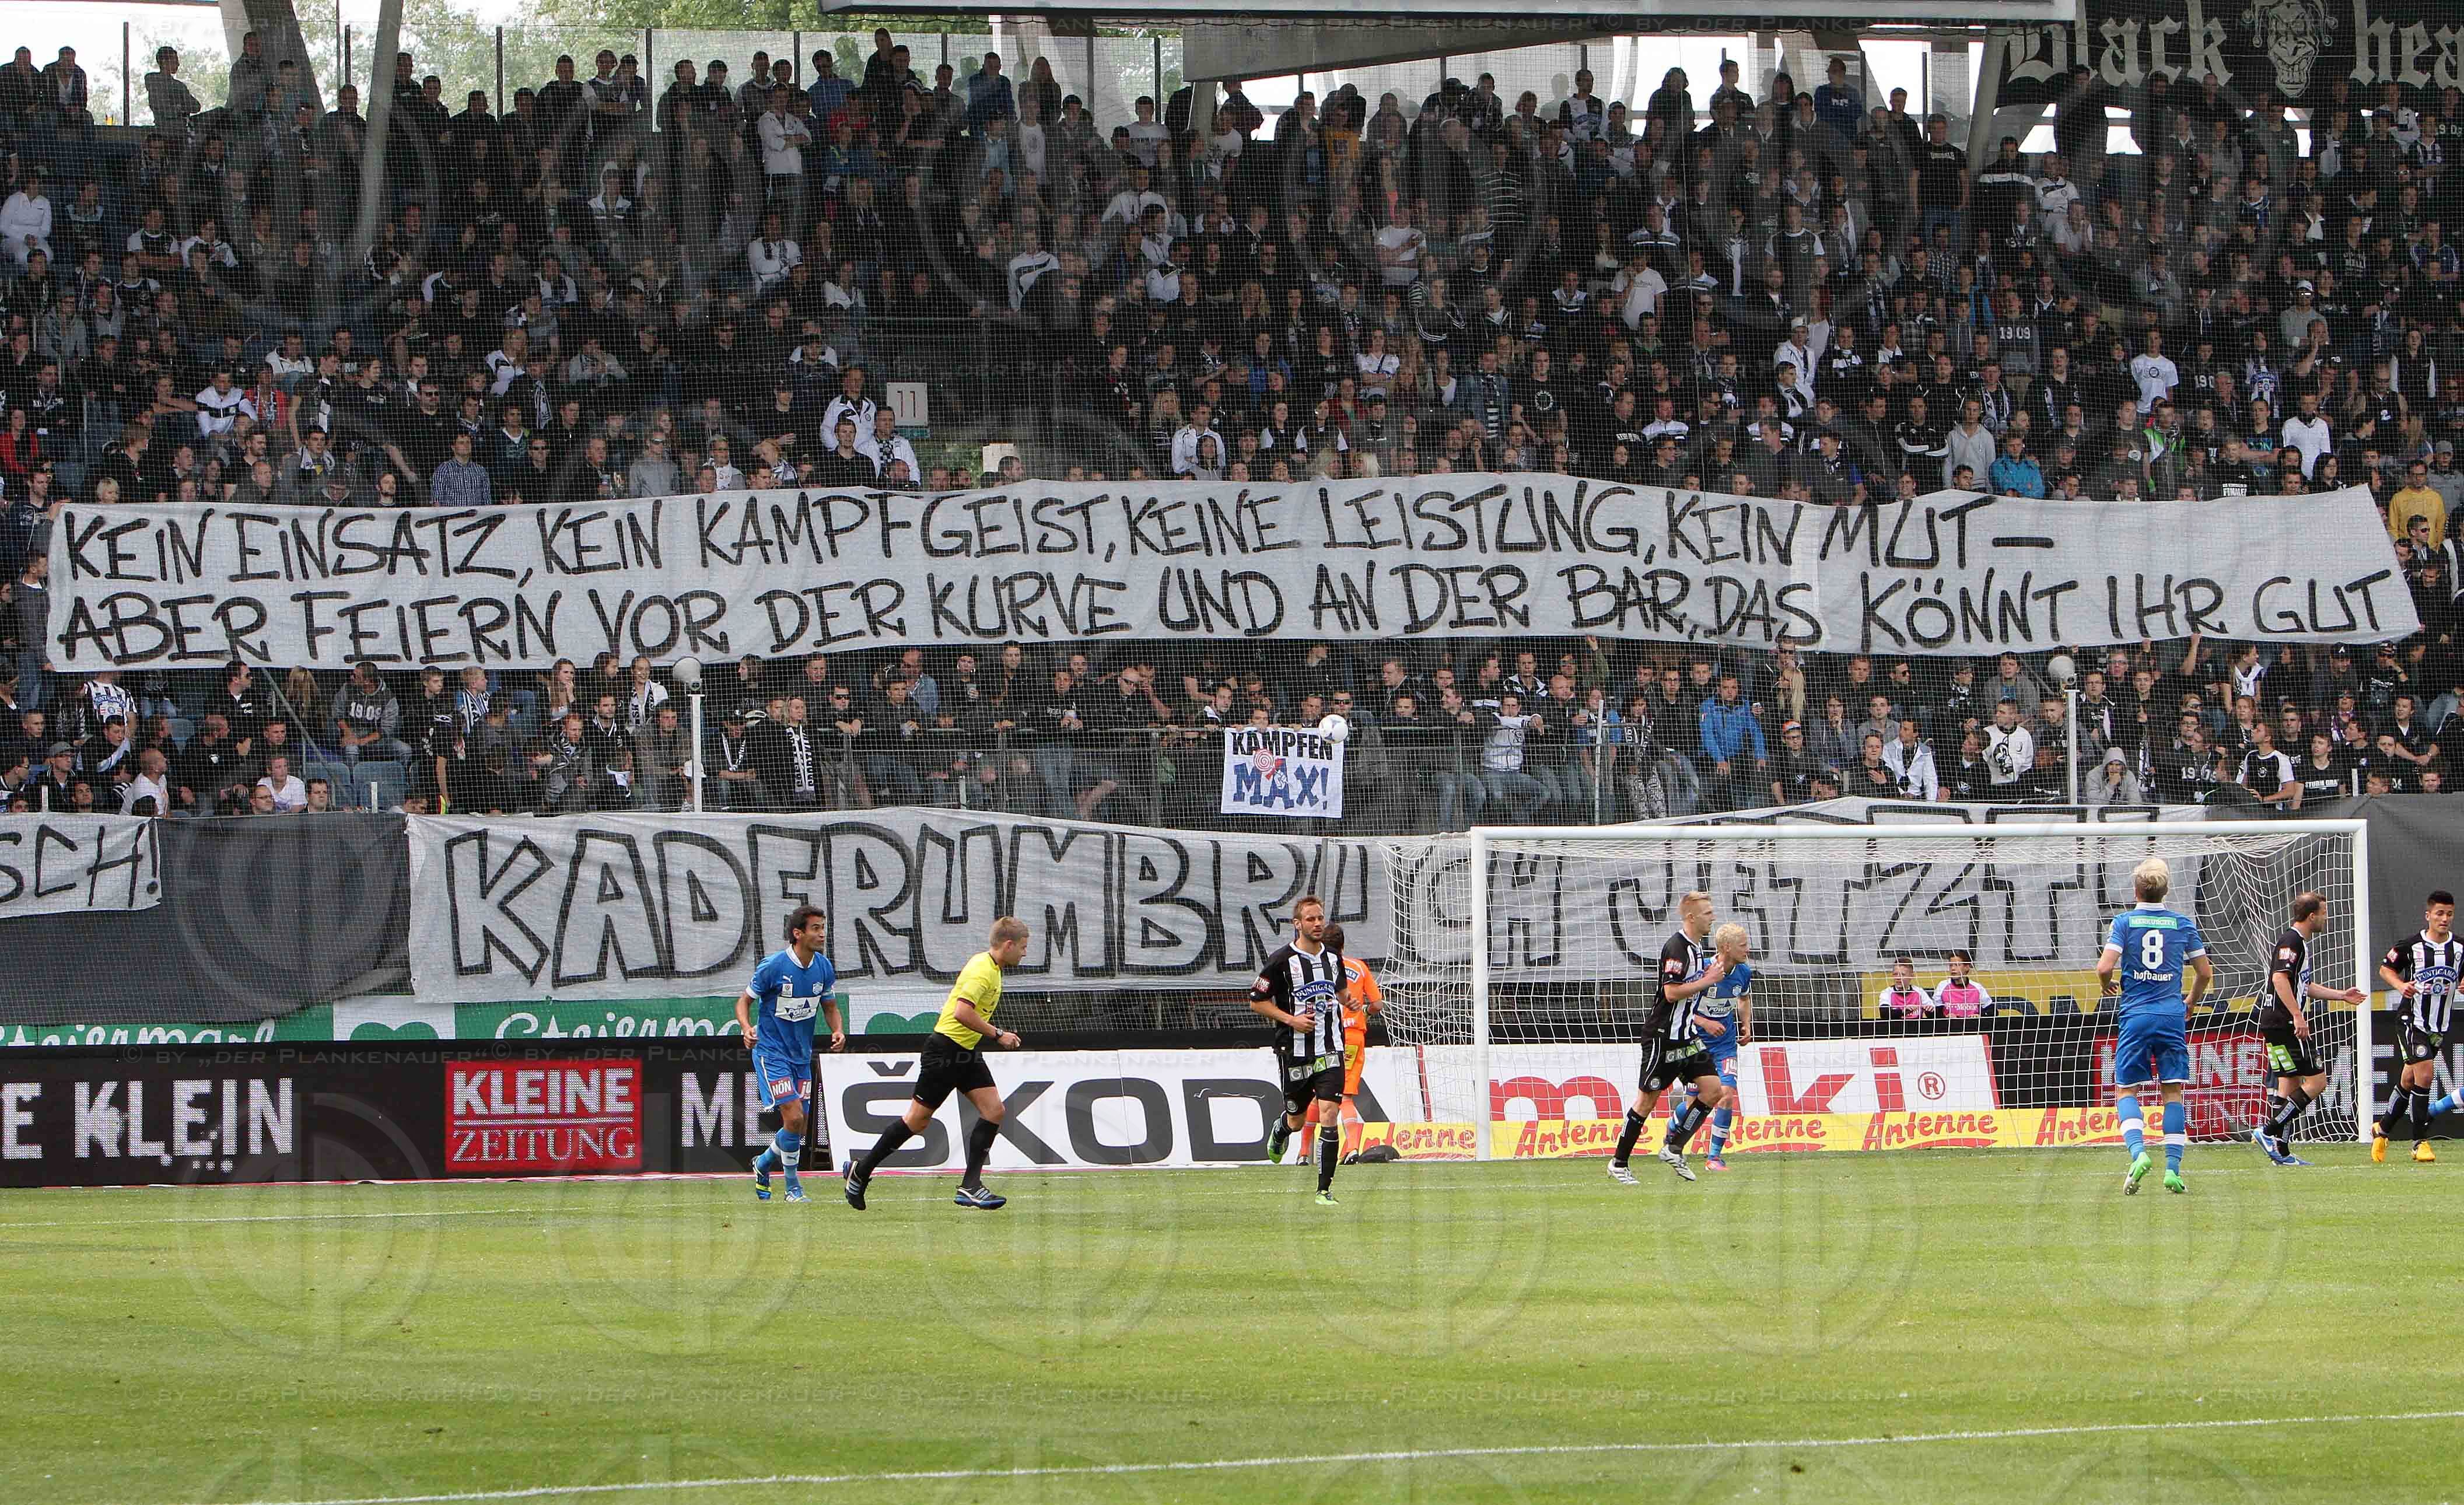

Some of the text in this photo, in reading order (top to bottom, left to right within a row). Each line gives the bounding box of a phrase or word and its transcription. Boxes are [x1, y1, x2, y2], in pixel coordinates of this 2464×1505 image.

[2005, 0, 2234, 88] Black
[2194, 374, 2215, 388] 190
[897, 390, 919, 418] 11
[65, 508, 215, 585] KEIN
[226, 509, 533, 589] EINSATZ,
[536, 499, 663, 575] KEIN
[696, 491, 1115, 568] KAMPFGEIST,
[1121, 488, 1301, 556] KEINE
[1318, 480, 1657, 565] LEISTUNG,
[1667, 491, 1804, 566] KEIN
[1819, 495, 1997, 569] MUT
[57, 559, 2392, 666] ABER FEIERN VOR DER KURVE UND AN DER BAR, DAS KÖNNT IHR GUT
[1233, 758, 1329, 810] MAX!
[2141, 929, 2164, 970] 8
[2133, 970, 2174, 981] hofbauer
[1666, 1040, 1707, 1062] GRAZ
[453, 1066, 635, 1114] KLEINE
[772, 1080, 792, 1096] NÖN
[1488, 1046, 1906, 1121] mki
[74, 1077, 295, 1161] KLEIN
[841, 1061, 1391, 1167] ŠKOD
[1862, 1111, 1999, 1152] Antenne
[453, 1126, 636, 1162] ZEITUNG
